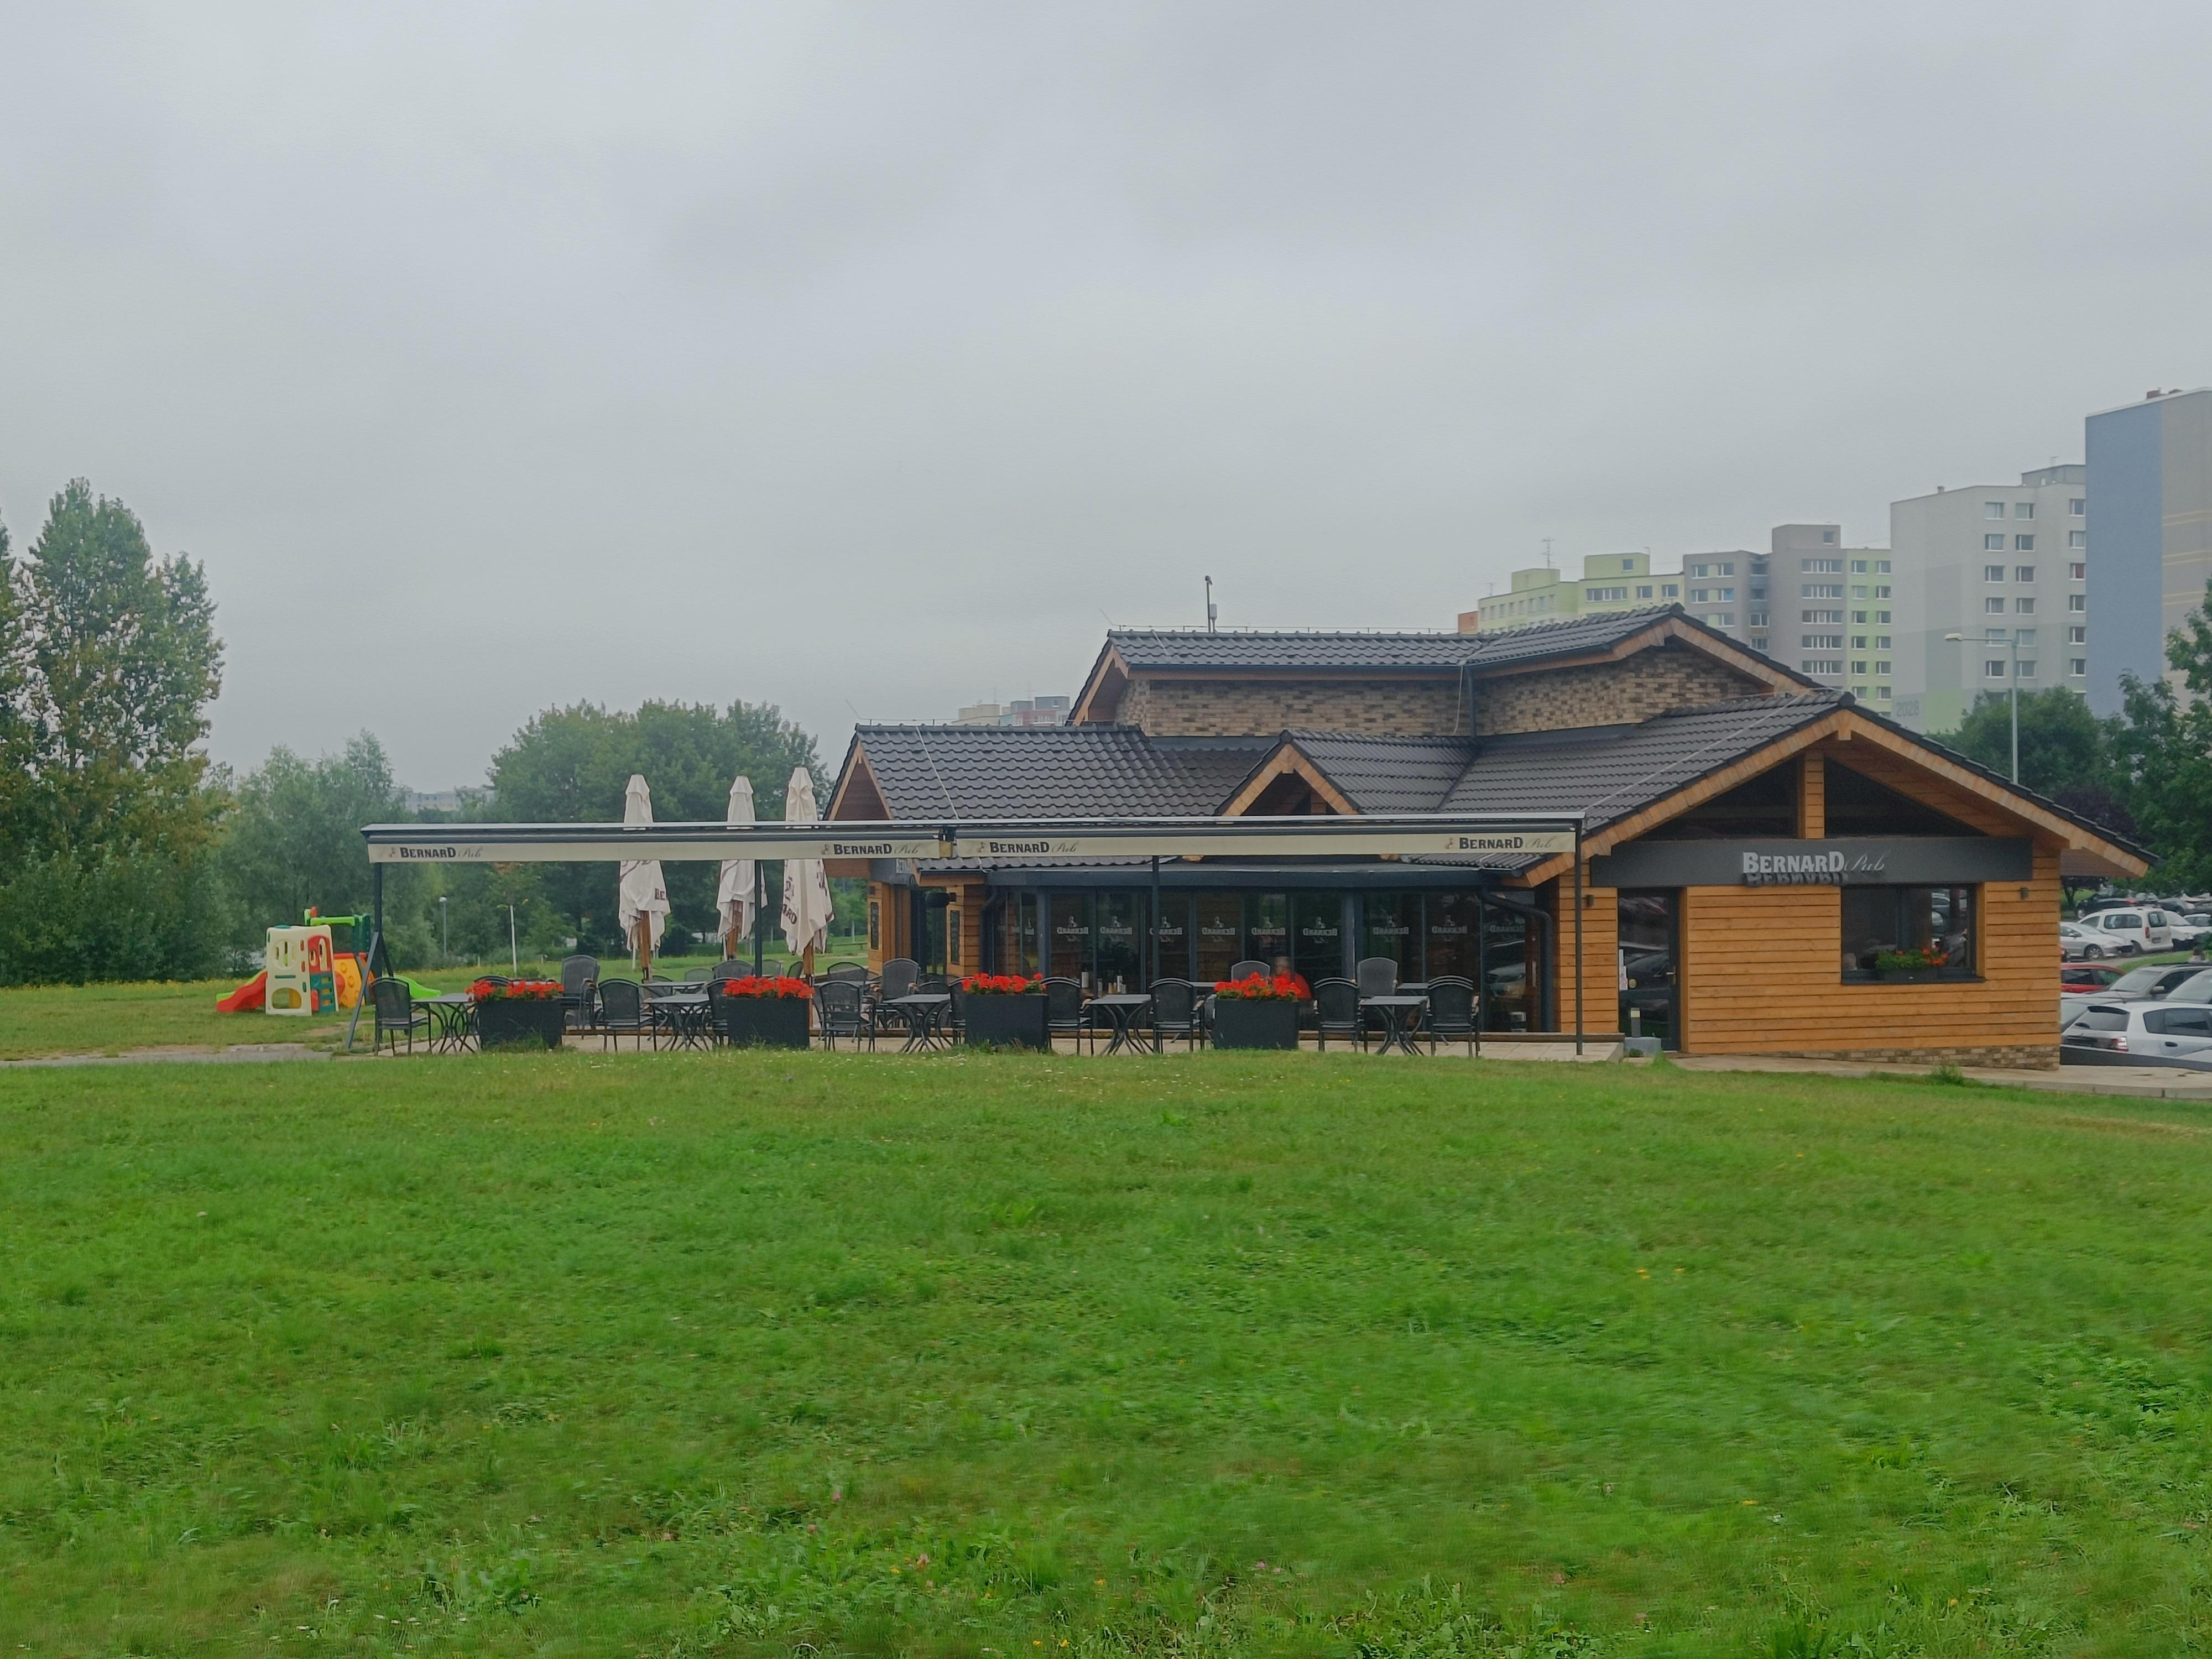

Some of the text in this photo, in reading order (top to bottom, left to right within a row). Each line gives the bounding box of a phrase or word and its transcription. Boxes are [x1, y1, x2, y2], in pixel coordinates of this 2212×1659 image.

[833, 843, 893, 855] BERNARD
[990, 841, 1050, 853] BERNARD
[1459, 837, 1524, 849] BERNARD
[400, 847, 456, 858] BERNARD
[1743, 851, 1889, 873] BERNARD Pub
